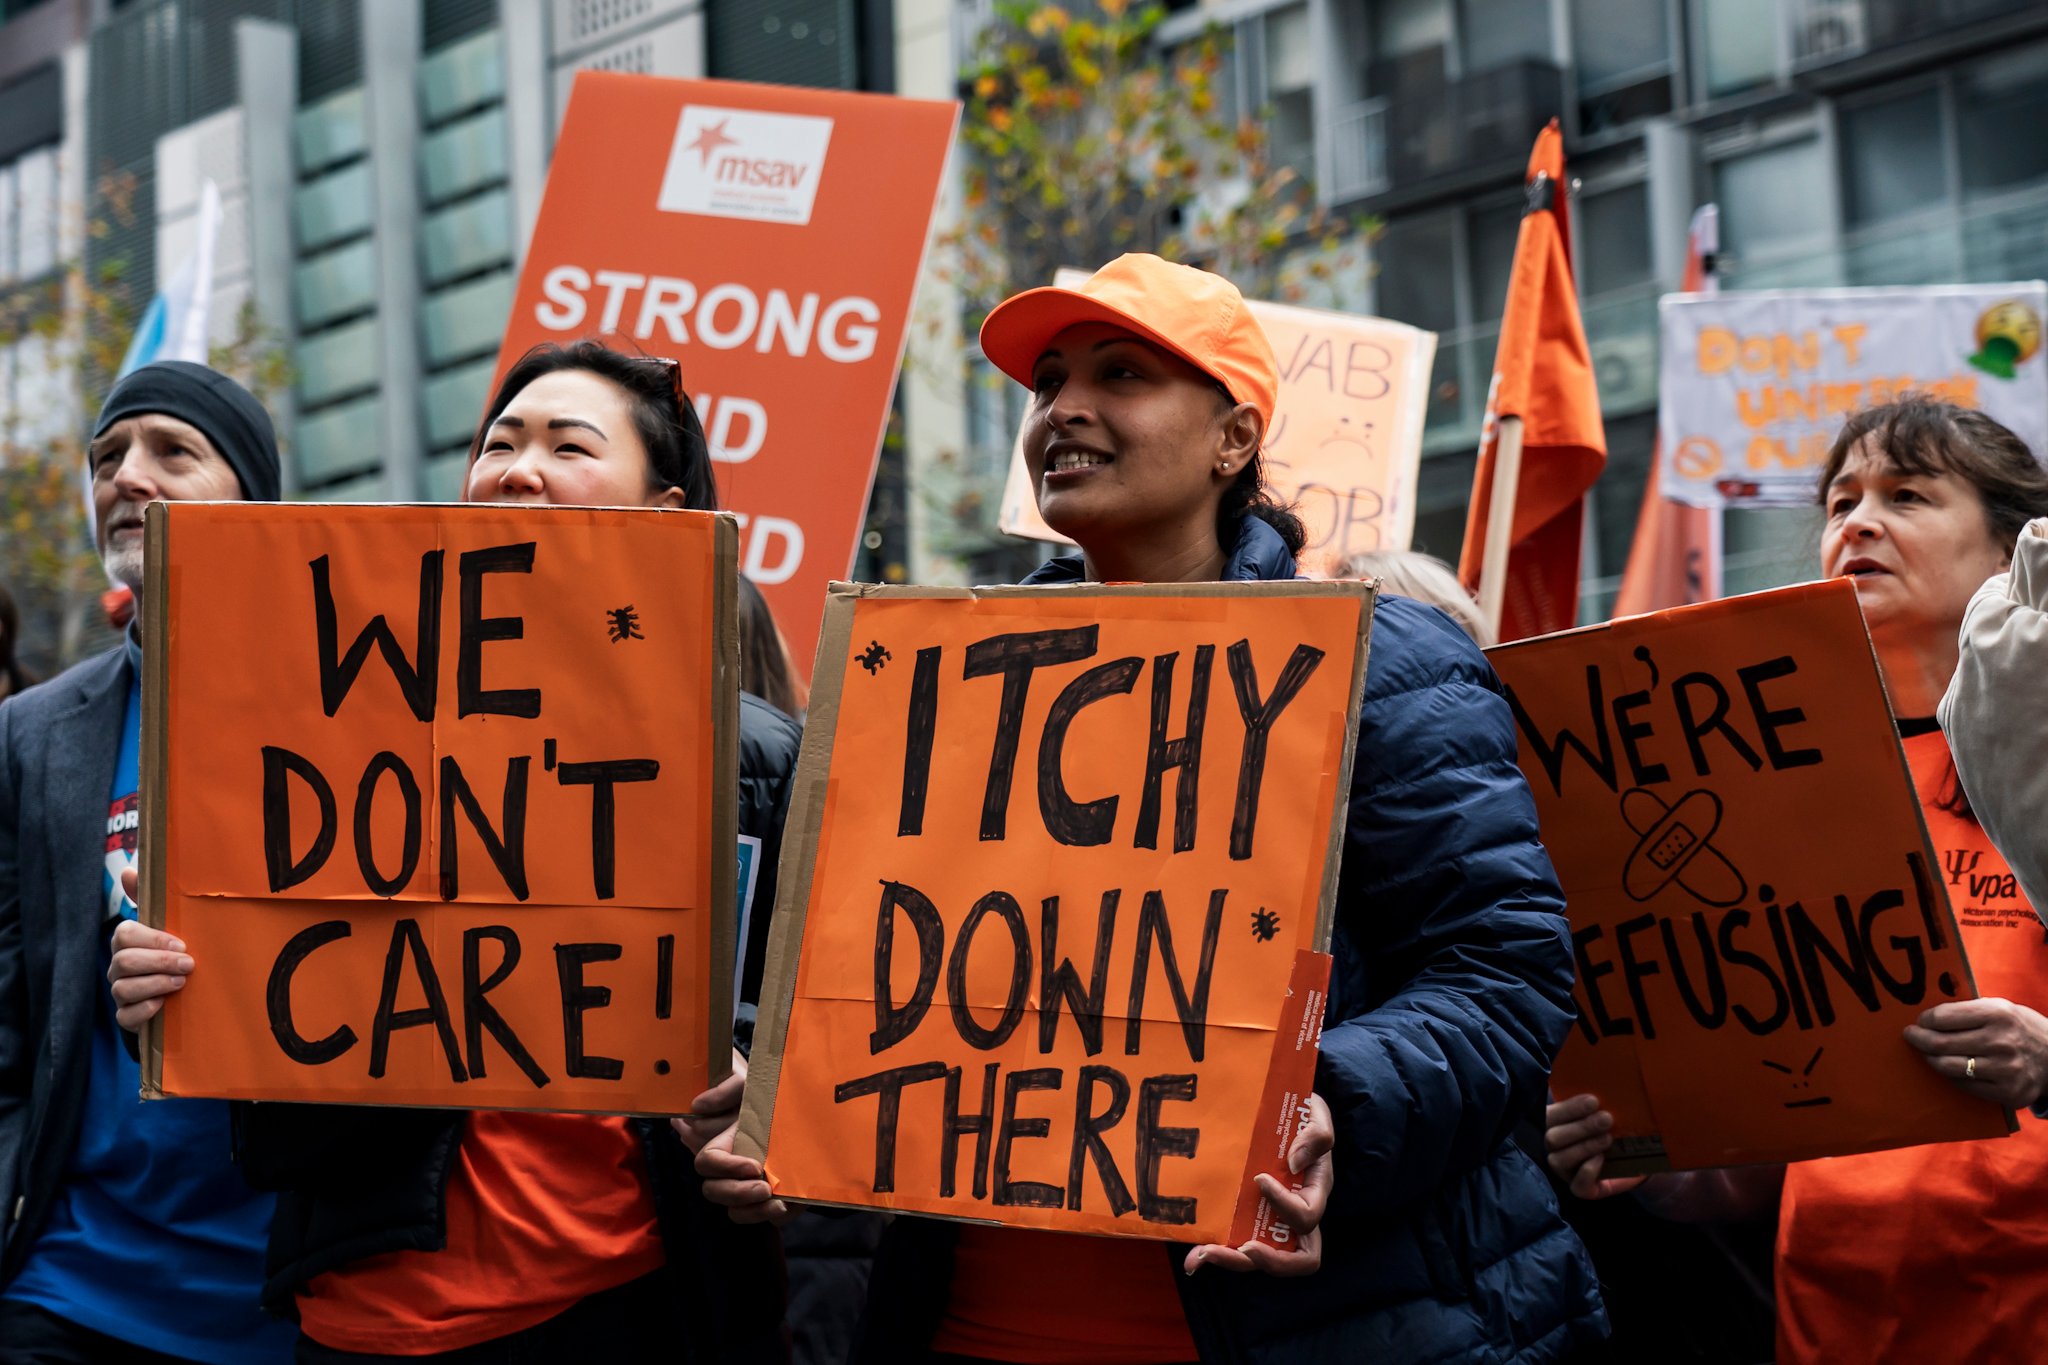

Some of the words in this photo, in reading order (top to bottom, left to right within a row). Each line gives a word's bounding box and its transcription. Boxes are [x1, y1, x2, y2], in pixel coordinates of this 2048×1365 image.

[715, 155, 808, 190] msav
[535, 265, 881, 363] STRONG
[309, 542, 542, 723] WE
[1503, 645, 1824, 798] WE'RE
[897, 623, 1326, 861] ITCHY
[262, 738, 661, 902] DON'T
[1969, 873, 2017, 906] vpa
[870, 879, 1229, 1063] DOWN
[266, 918, 676, 1090] CARE!
[1302, 990, 1315, 1022] association
[1311, 991, 1322, 1015] medical
[1295, 1030, 1305, 1051] victoria
[1301, 1022, 1308, 1030] of
[1305, 1015, 1316, 1042] scientists
[1279, 1091, 1290, 1125] association
[1287, 1094, 1298, 1119] victorian
[834, 1060, 1200, 1224] THERE
[1275, 1126, 1283, 1136] inc
[1277, 1118, 1291, 1159] psychologists
